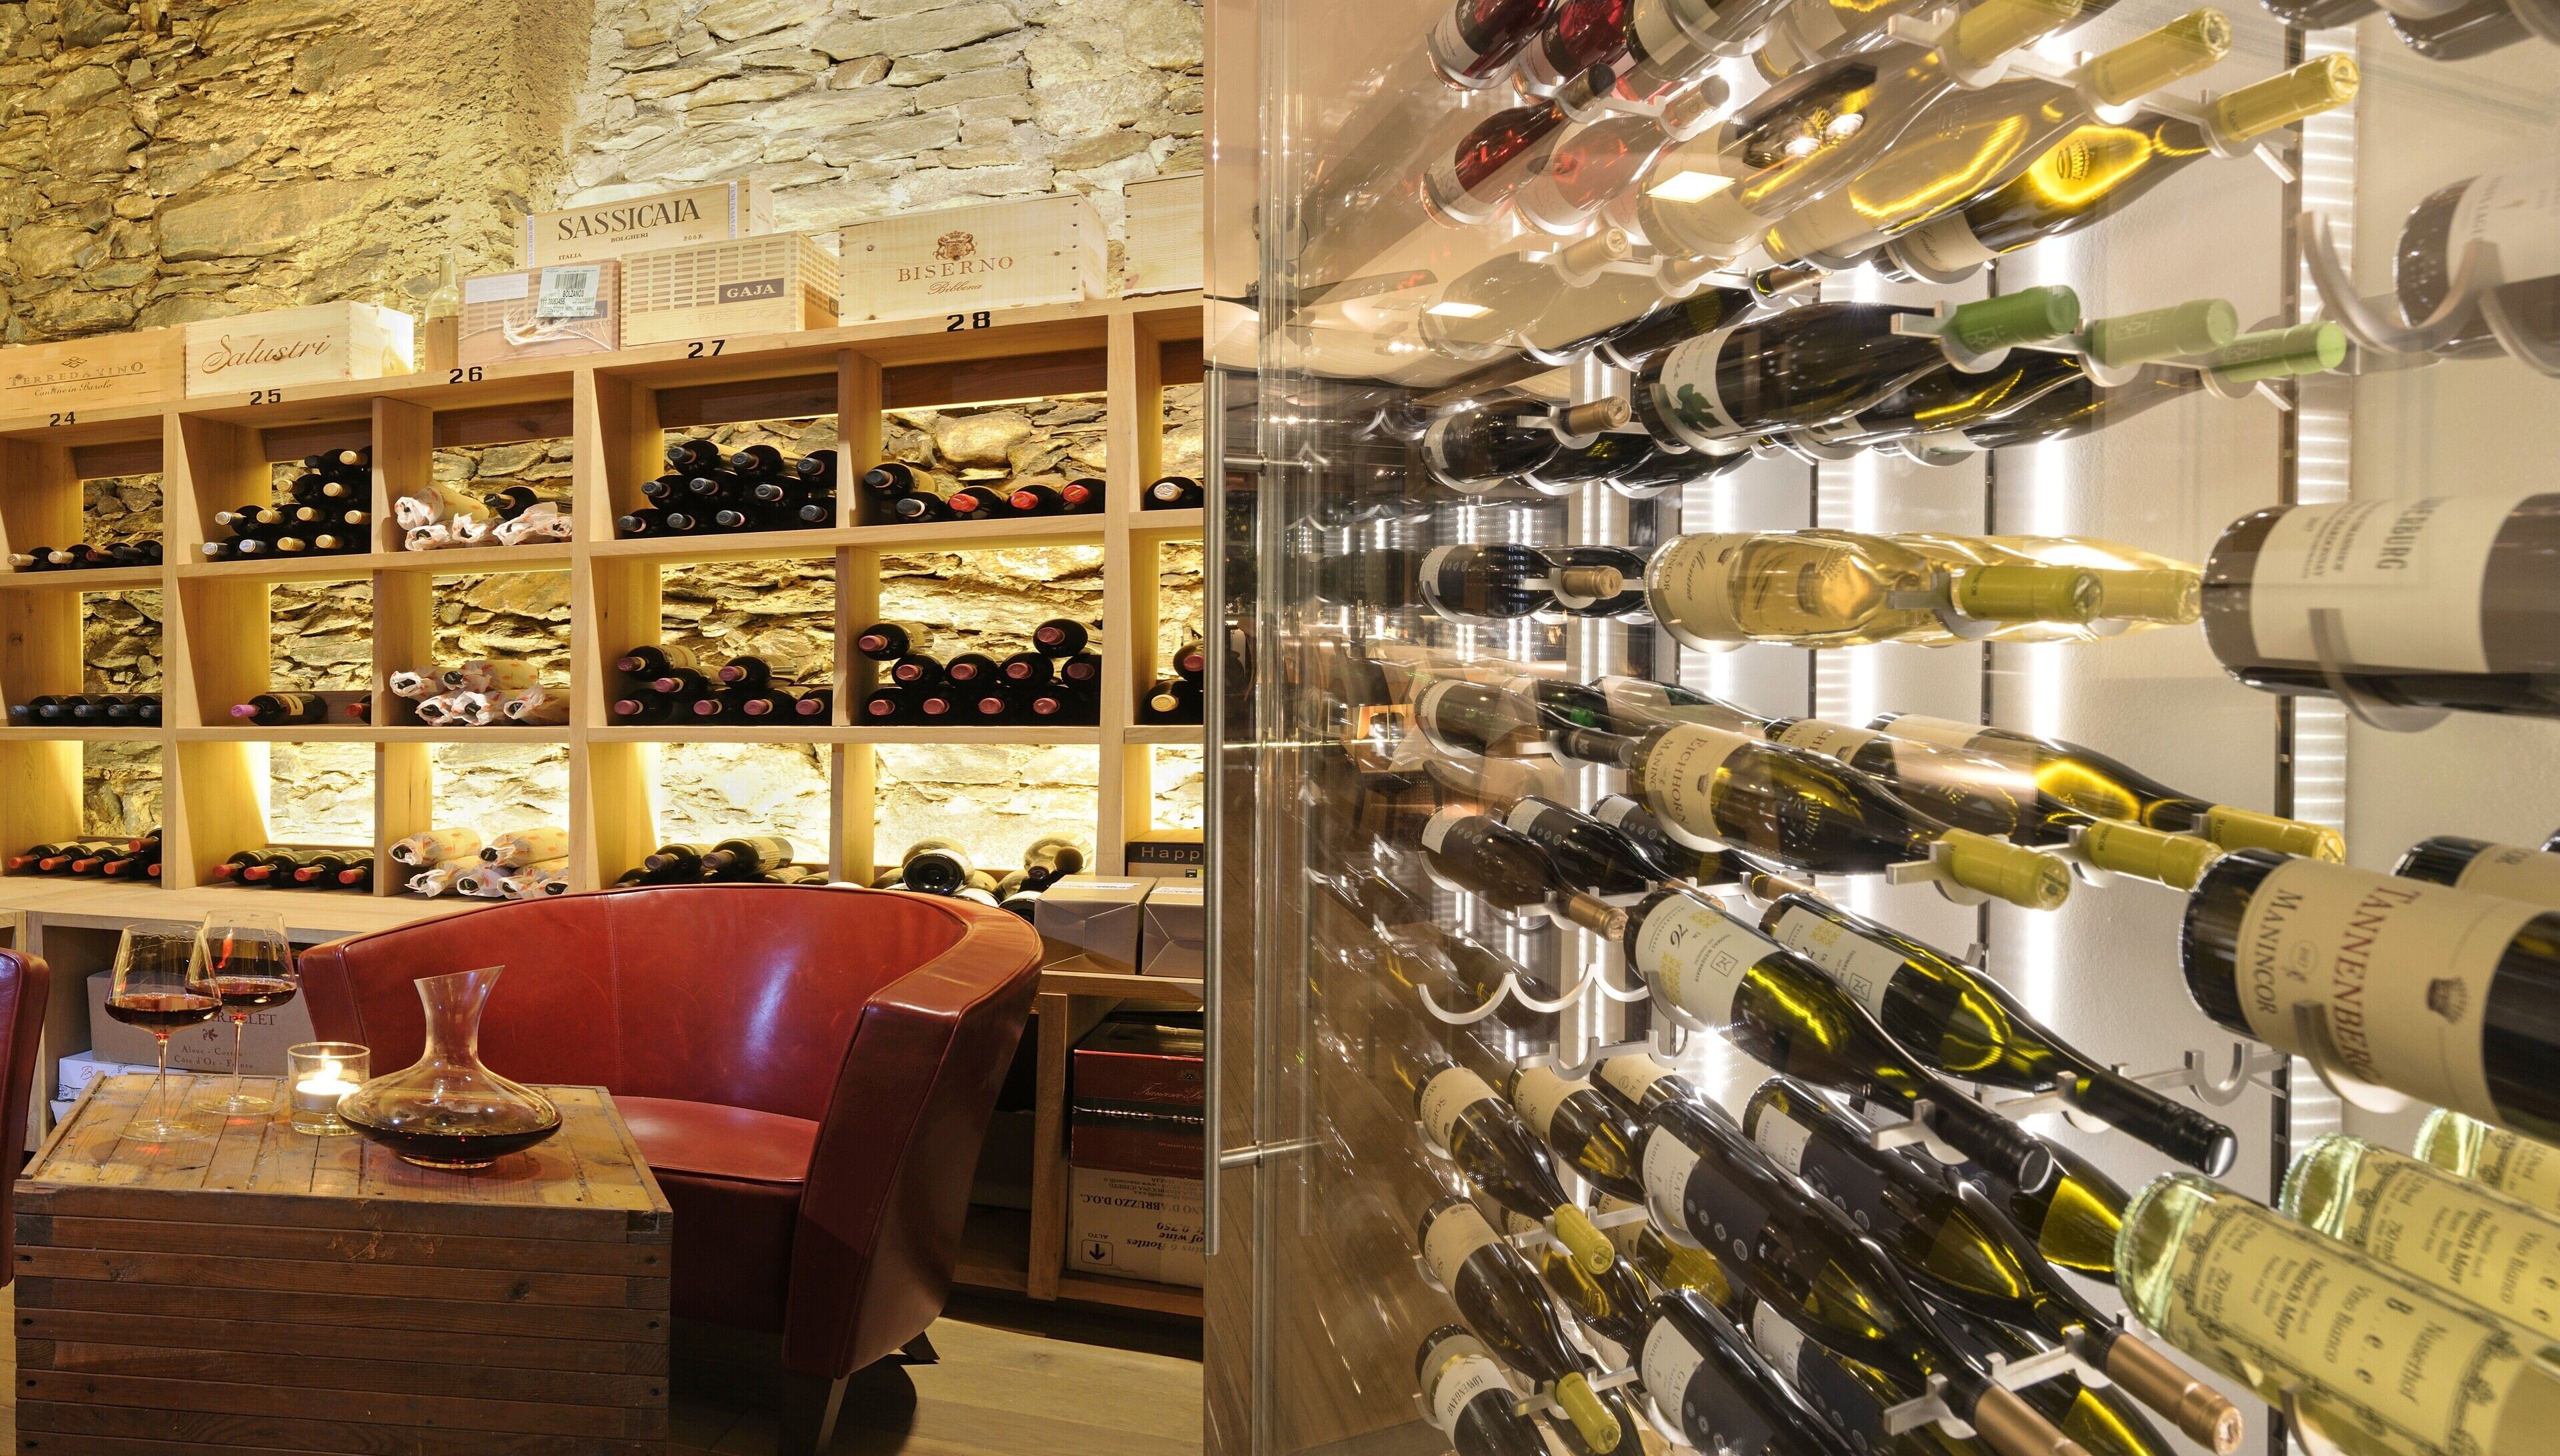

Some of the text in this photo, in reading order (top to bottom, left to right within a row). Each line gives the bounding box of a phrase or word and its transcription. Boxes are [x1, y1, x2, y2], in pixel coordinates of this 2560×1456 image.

[558, 199, 701, 241] SASSICAIA
[611, 233, 649, 243] BOLGHERI
[558, 253, 582, 261] ITALIA
[898, 256, 1013, 282] BISERNO
[727, 284, 776, 298] GAJA
[927, 281, 982, 295] Bibbona
[947, 311, 991, 332] 28
[201, 334, 332, 374] Salustri
[688, 339, 725, 359] 27
[449, 365, 483, 384] 26
[79, 379, 115, 391] Barolo
[250, 389, 282, 405] 25
[50, 411, 76, 427] 24
[1672, 738, 1708, 824] EICHHORN
[1670, 924, 1689, 949] 76
[2253, 888, 2305, 1015] MANINCOR
[181, 1045, 243, 1057] Aloxe Cortn
[195, 1055, 217, 1066] d'Or
[227, 1059, 254, 1069] Frnce
[1133, 1083, 1184, 1101] Francesco
[1158, 1141, 1187, 1150] SPUMANTE
[1079, 1194, 1112, 1205] D.O.C.
[1127, 1238, 1166, 1251] Bottles
[1159, 1232, 1204, 1244] of wine
[1671, 1371, 1686, 1417] GAUN
